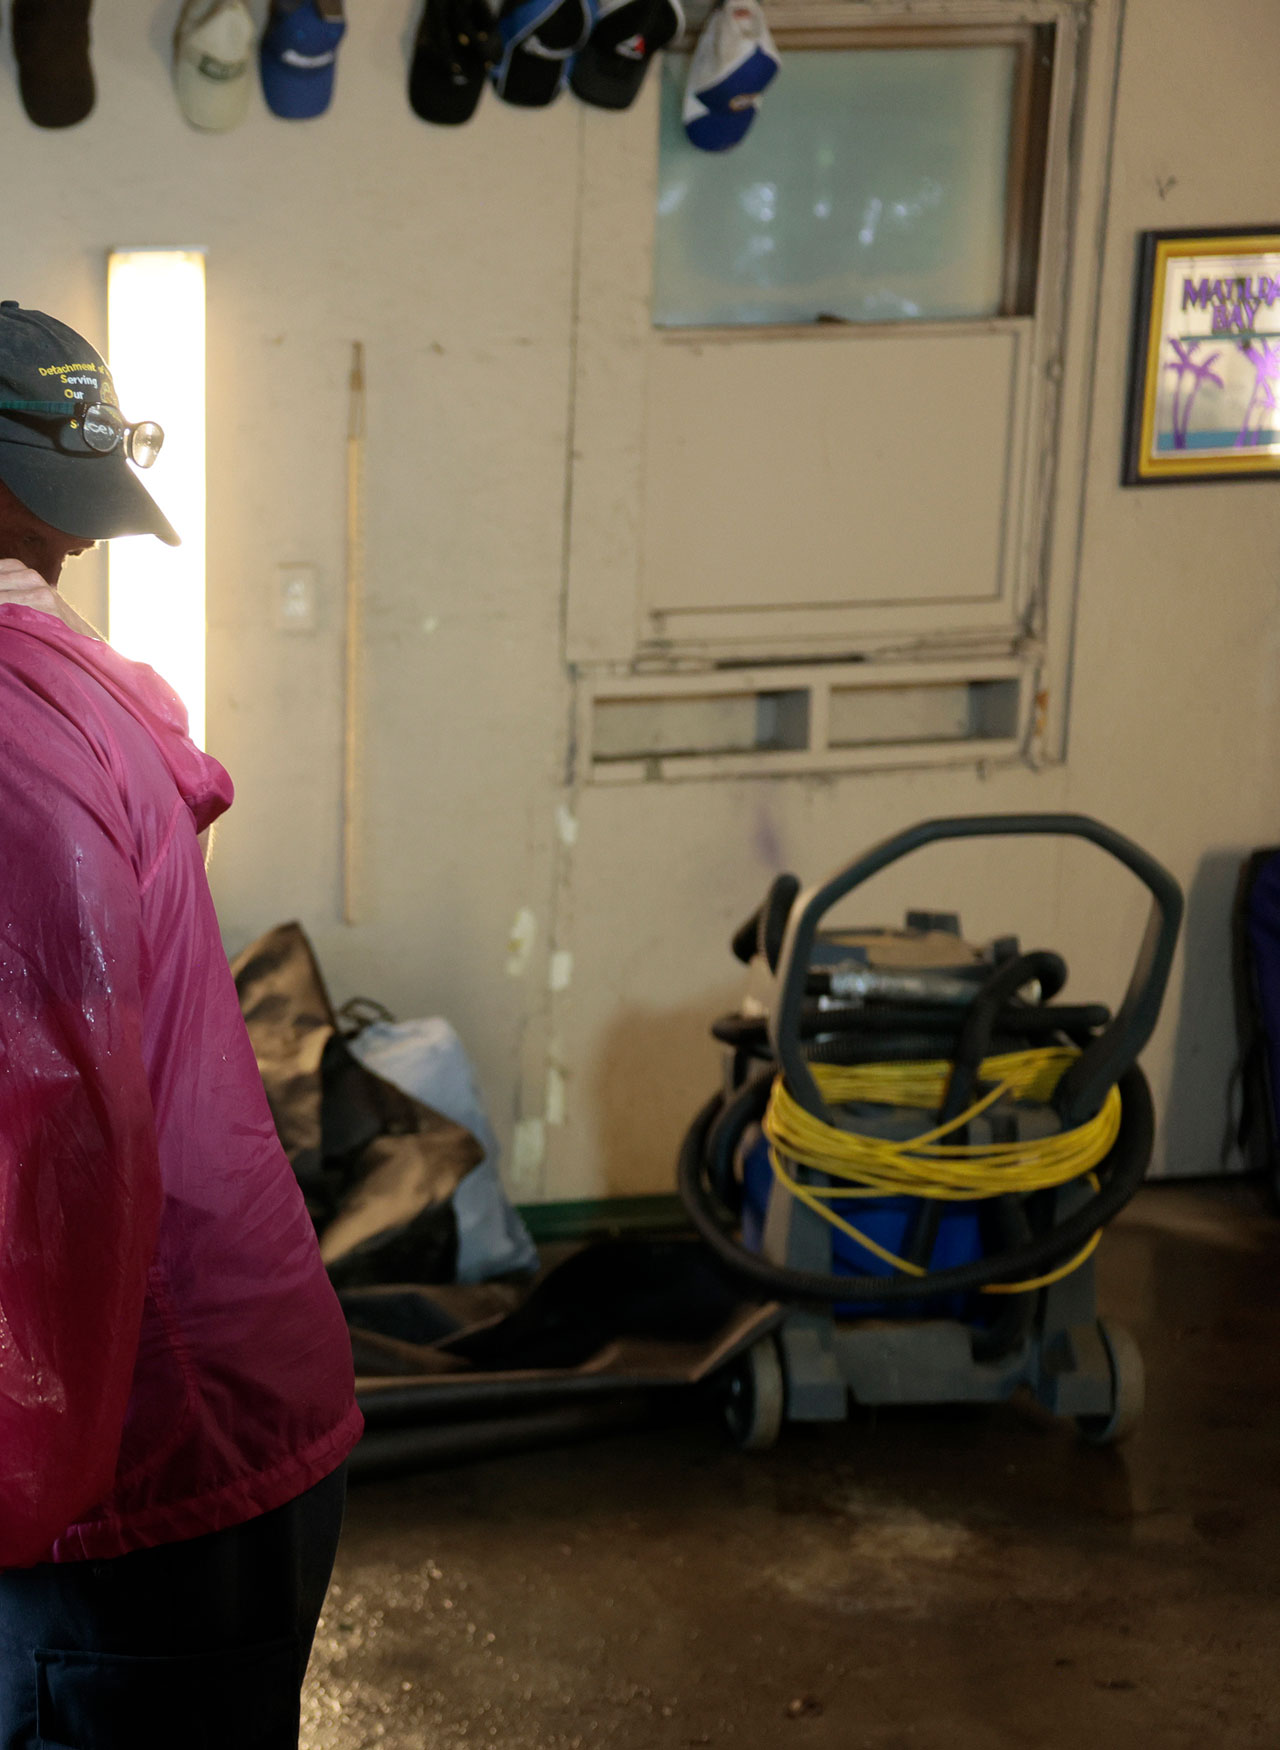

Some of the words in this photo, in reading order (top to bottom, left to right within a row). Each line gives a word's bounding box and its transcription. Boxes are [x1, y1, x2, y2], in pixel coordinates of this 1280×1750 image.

[1211, 298, 1260, 333] BAY
[38, 363, 96, 376] Detachment
[60, 374, 98, 389] Serving
[64, 388, 84, 399] Our
